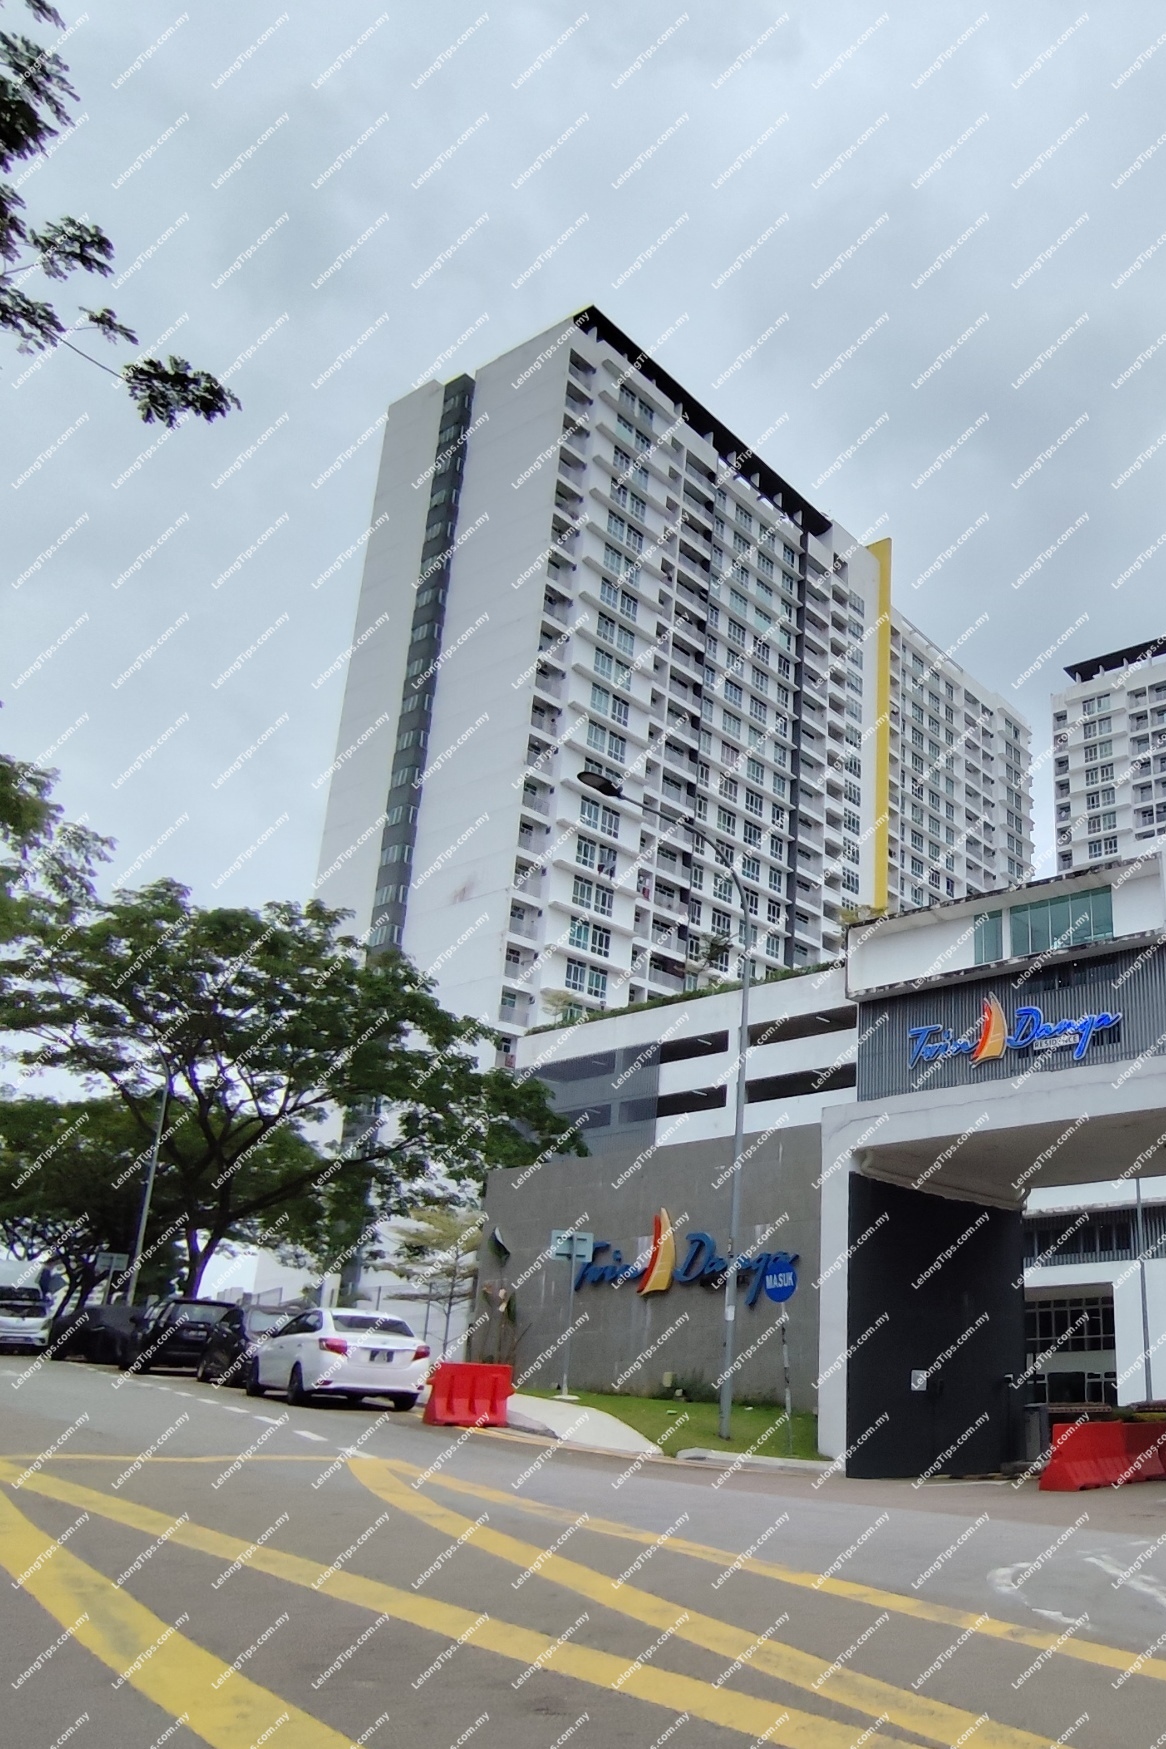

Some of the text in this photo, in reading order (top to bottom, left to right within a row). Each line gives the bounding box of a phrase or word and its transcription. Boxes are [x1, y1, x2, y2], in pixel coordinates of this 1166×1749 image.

[907, 1005, 1123, 1070] Twin Danga
[1034, 1035, 1078, 1049] RESIDNCE
[765, 1271, 795, 1289] MASUK
